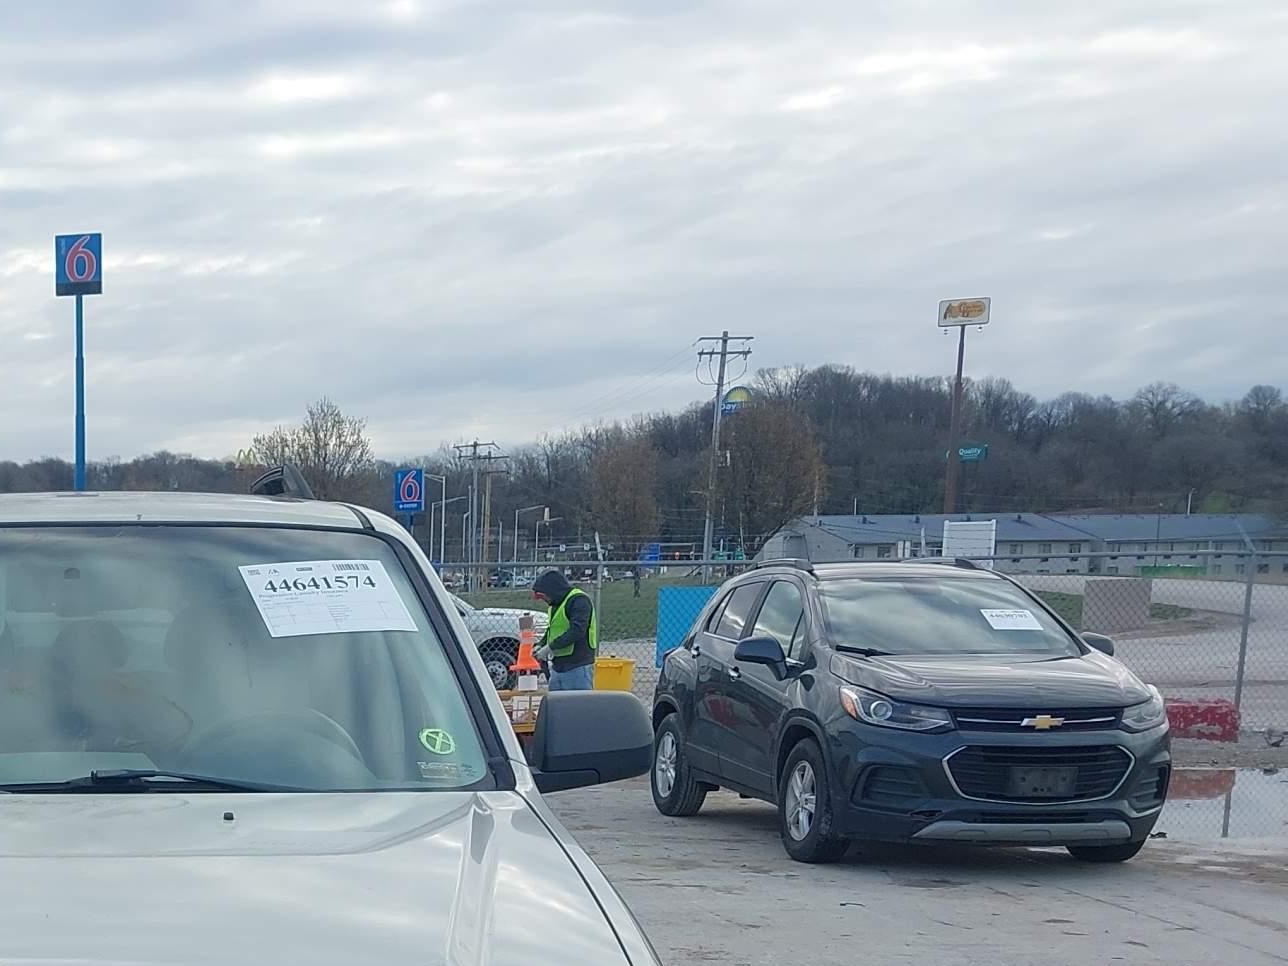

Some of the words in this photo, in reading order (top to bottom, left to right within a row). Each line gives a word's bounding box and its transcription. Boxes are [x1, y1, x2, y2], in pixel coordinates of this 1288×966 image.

[65, 235, 97, 282] 6
[400, 470, 420, 502] 6
[264, 575, 377, 593] 44641574
